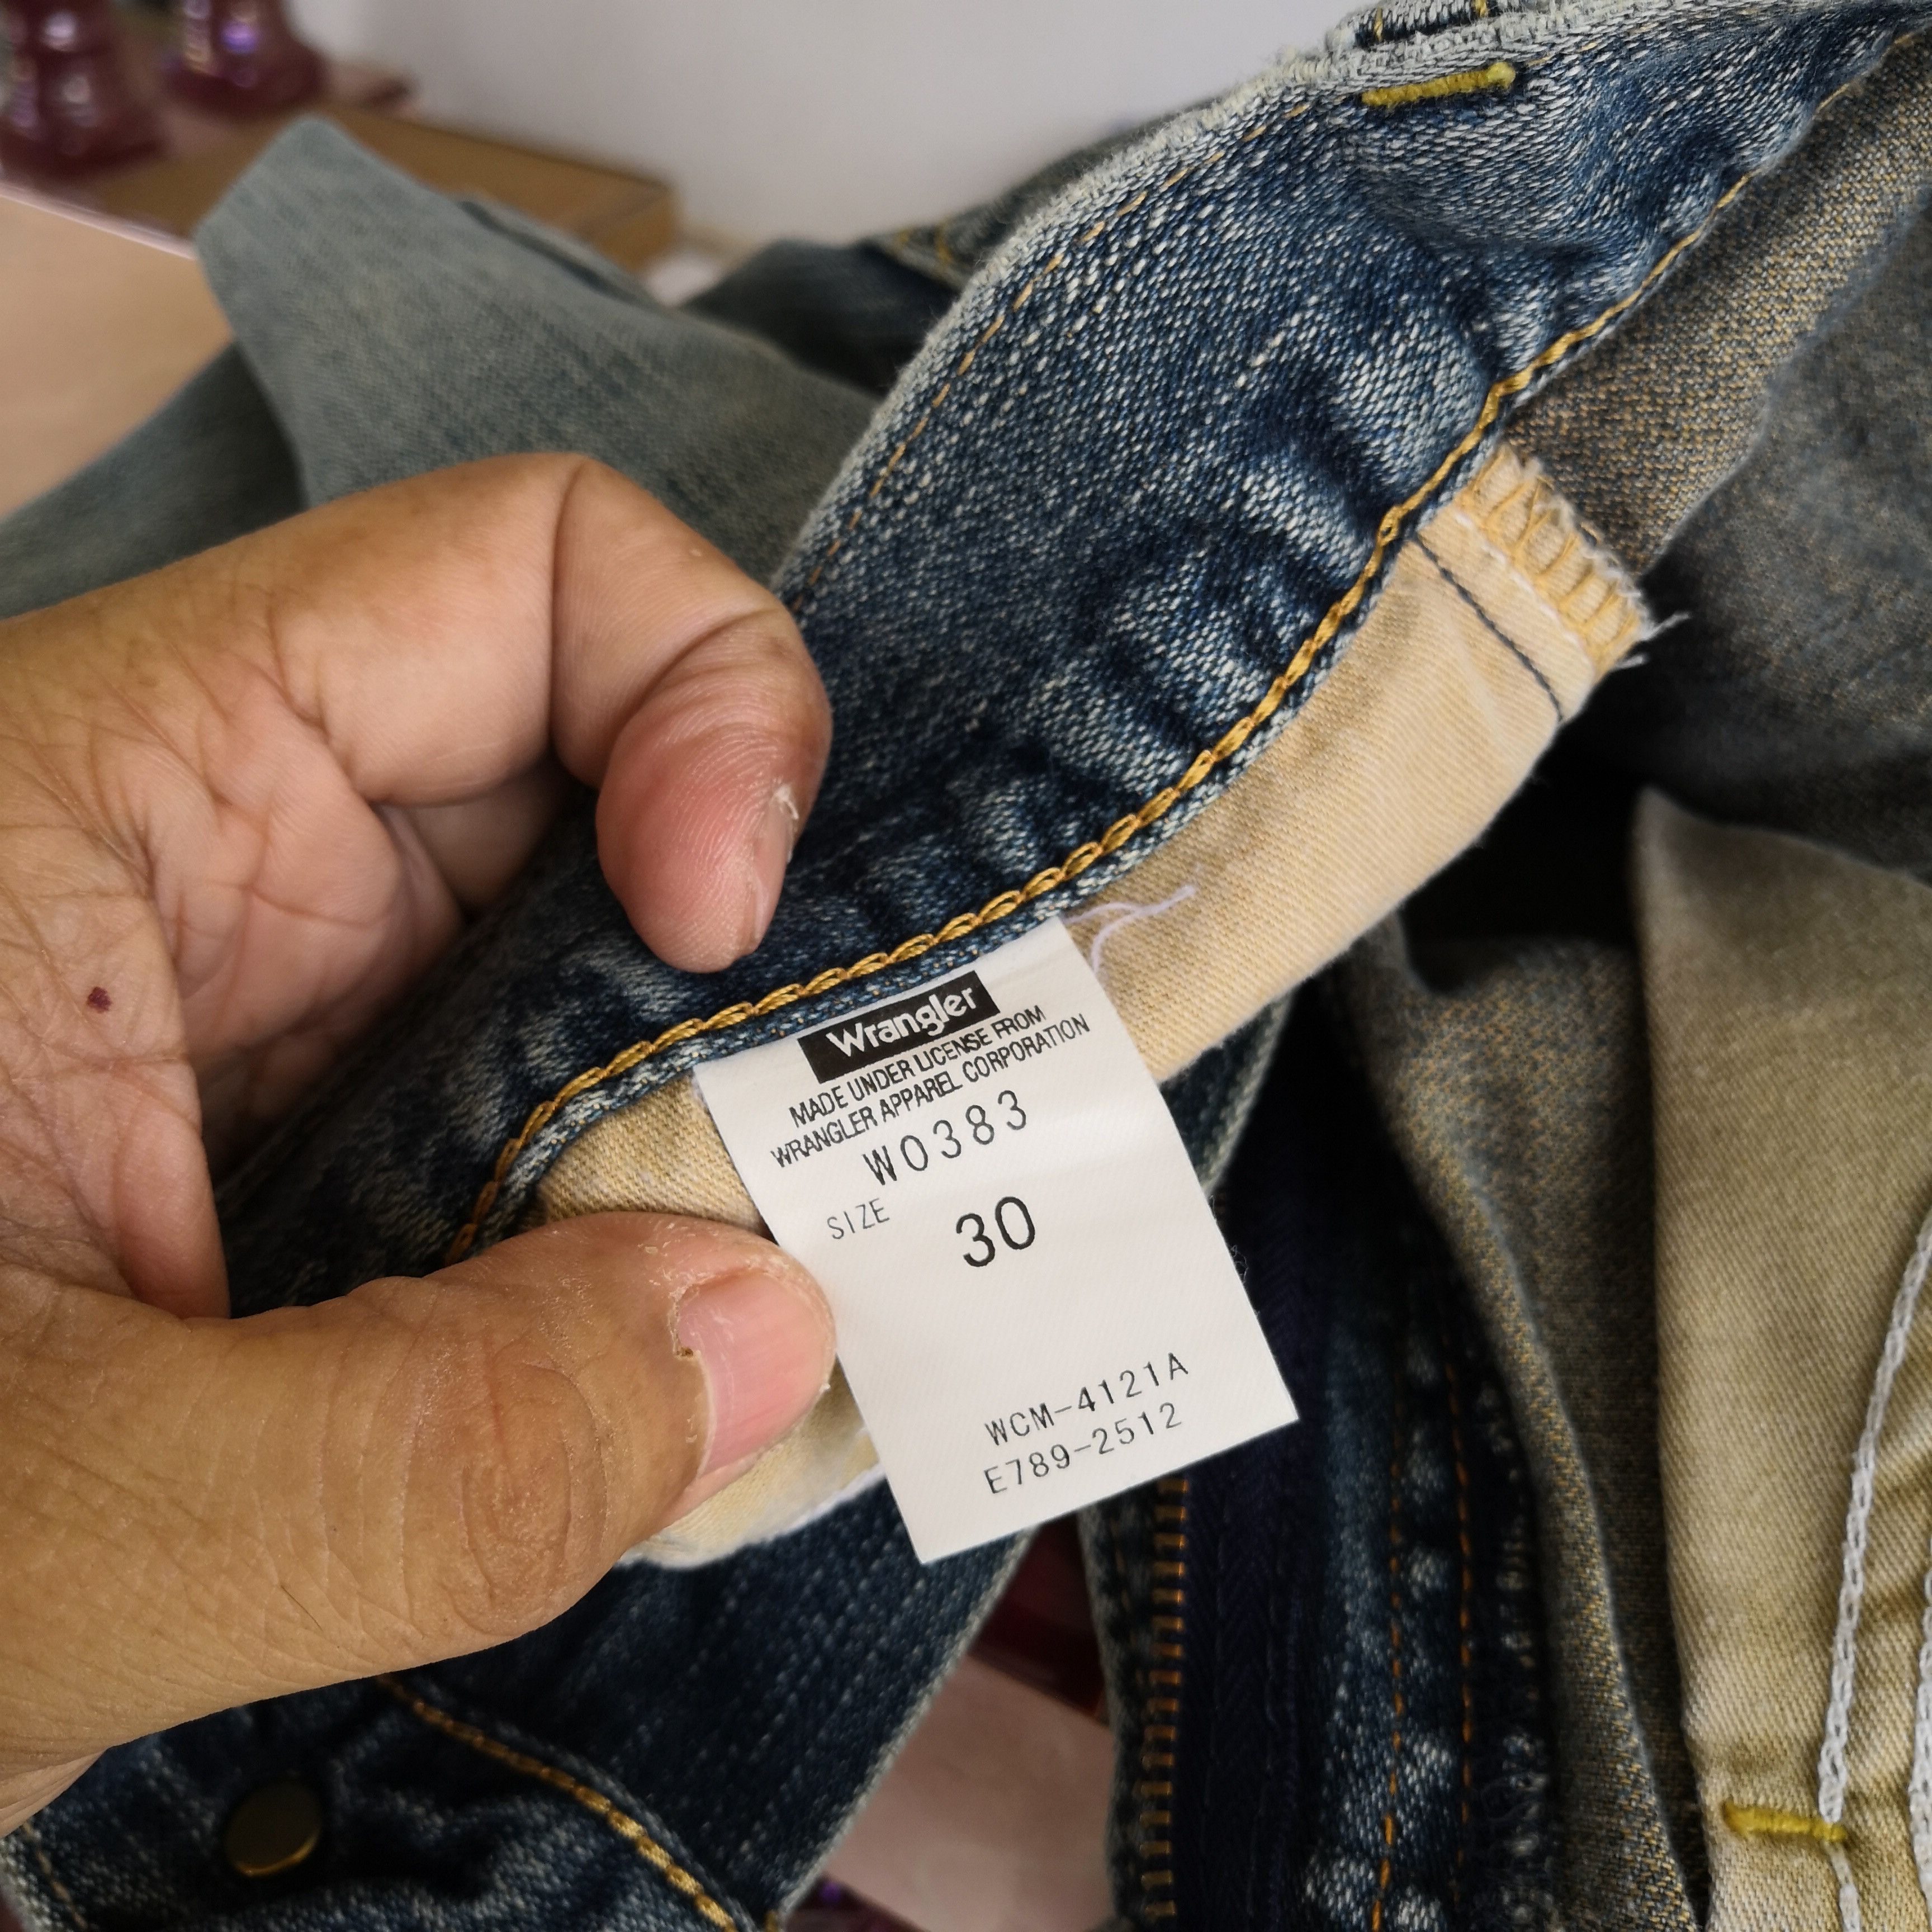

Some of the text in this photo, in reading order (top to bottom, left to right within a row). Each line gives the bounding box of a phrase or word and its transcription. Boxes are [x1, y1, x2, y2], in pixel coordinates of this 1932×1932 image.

[788, 1005, 1046, 1128] MADE UNDER LICENSE FROM
[826, 986, 978, 1058] Wrangler
[771, 1013, 1090, 1168] WRANGLER APPAREL CORPORATION
[863, 1090, 1027, 1186] W0383
[826, 1196, 1036, 1267] SIZE 30
[983, 1352, 1188, 1446] WCM-4121A
[983, 1402, 1182, 1494] E789-2512
